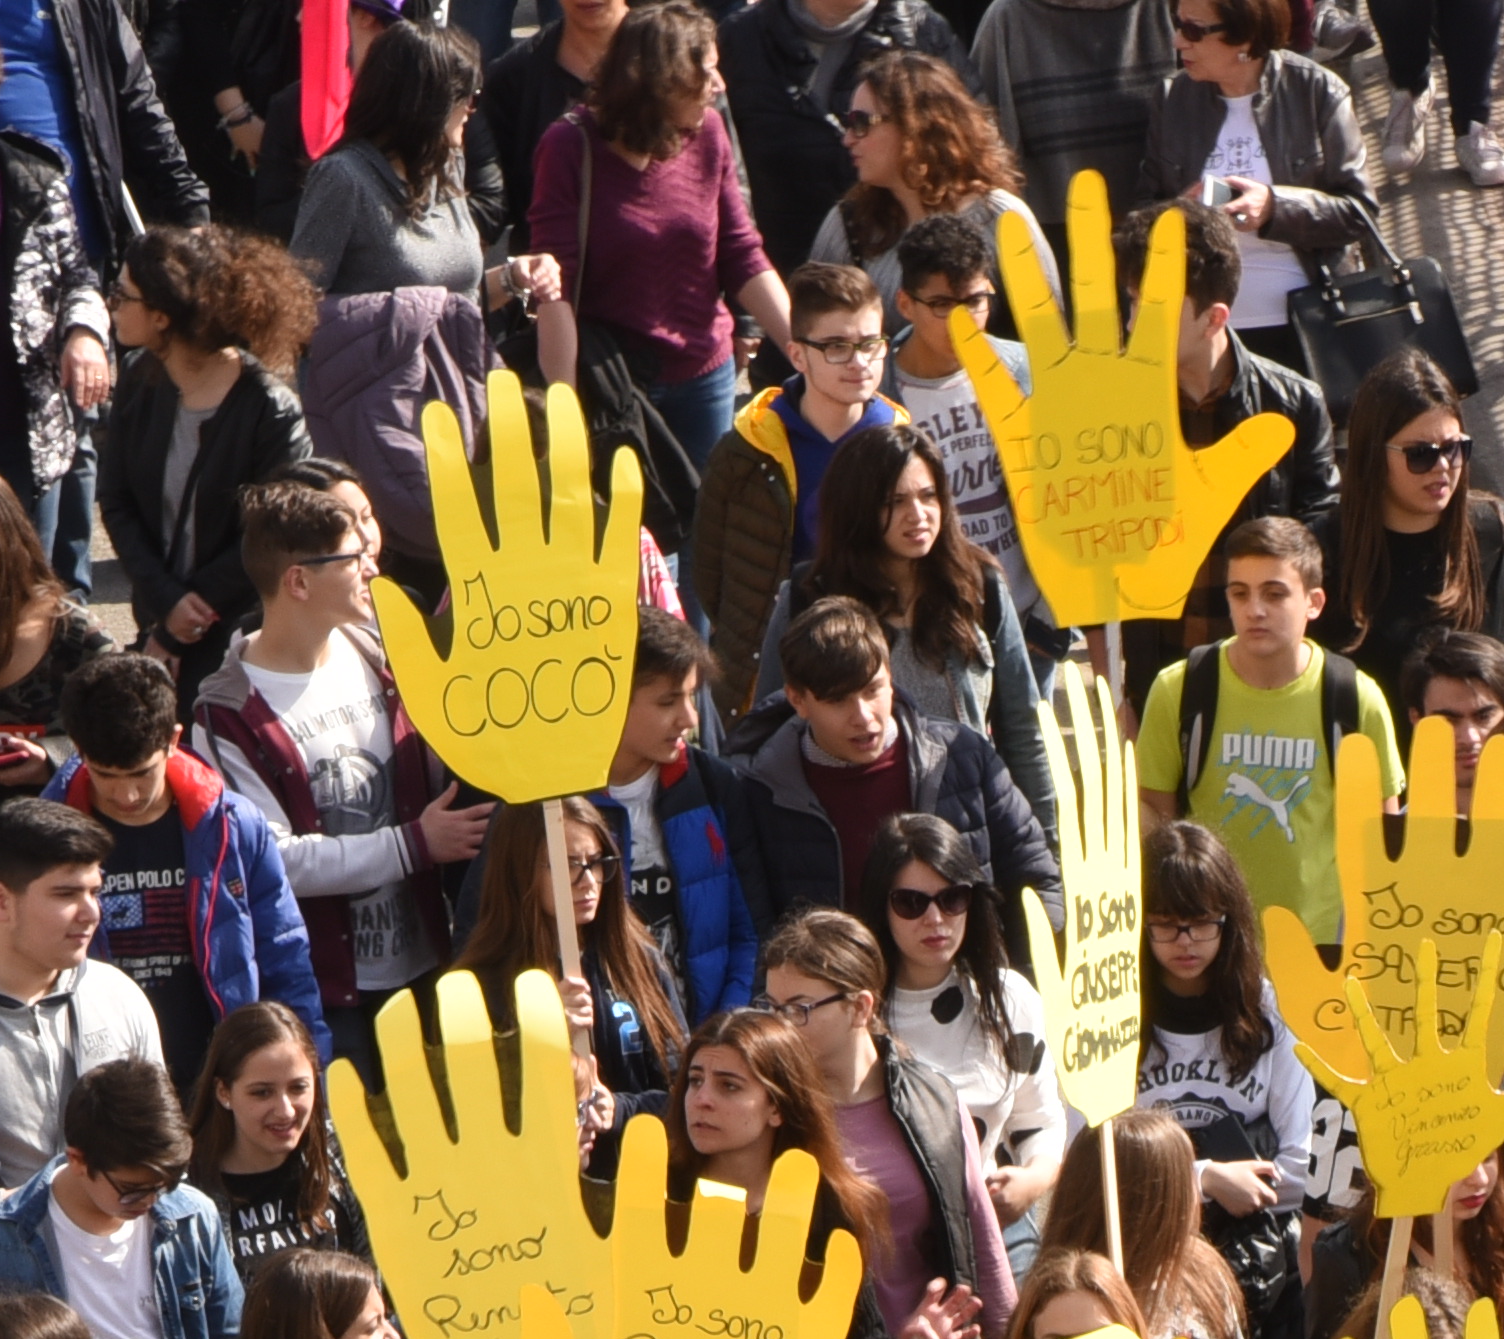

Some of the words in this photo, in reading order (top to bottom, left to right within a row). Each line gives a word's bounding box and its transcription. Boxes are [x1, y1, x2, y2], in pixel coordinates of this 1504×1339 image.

[1009, 434, 1061, 472] IO
[1077, 421, 1163, 464] SONO
[1016, 466, 1172, 525] CARMINE
[1061, 509, 1184, 559] TRIPODI
[528, 596, 611, 638] sono
[1223, 734, 1315, 769] PUMA
[137, 871, 170, 889] POLO
[1361, 882, 1423, 930] Io
[1136, 1058, 1264, 1104] ROOKLYN
[441, 1226, 549, 1280] sono
[647, 1285, 692, 1328] Io
